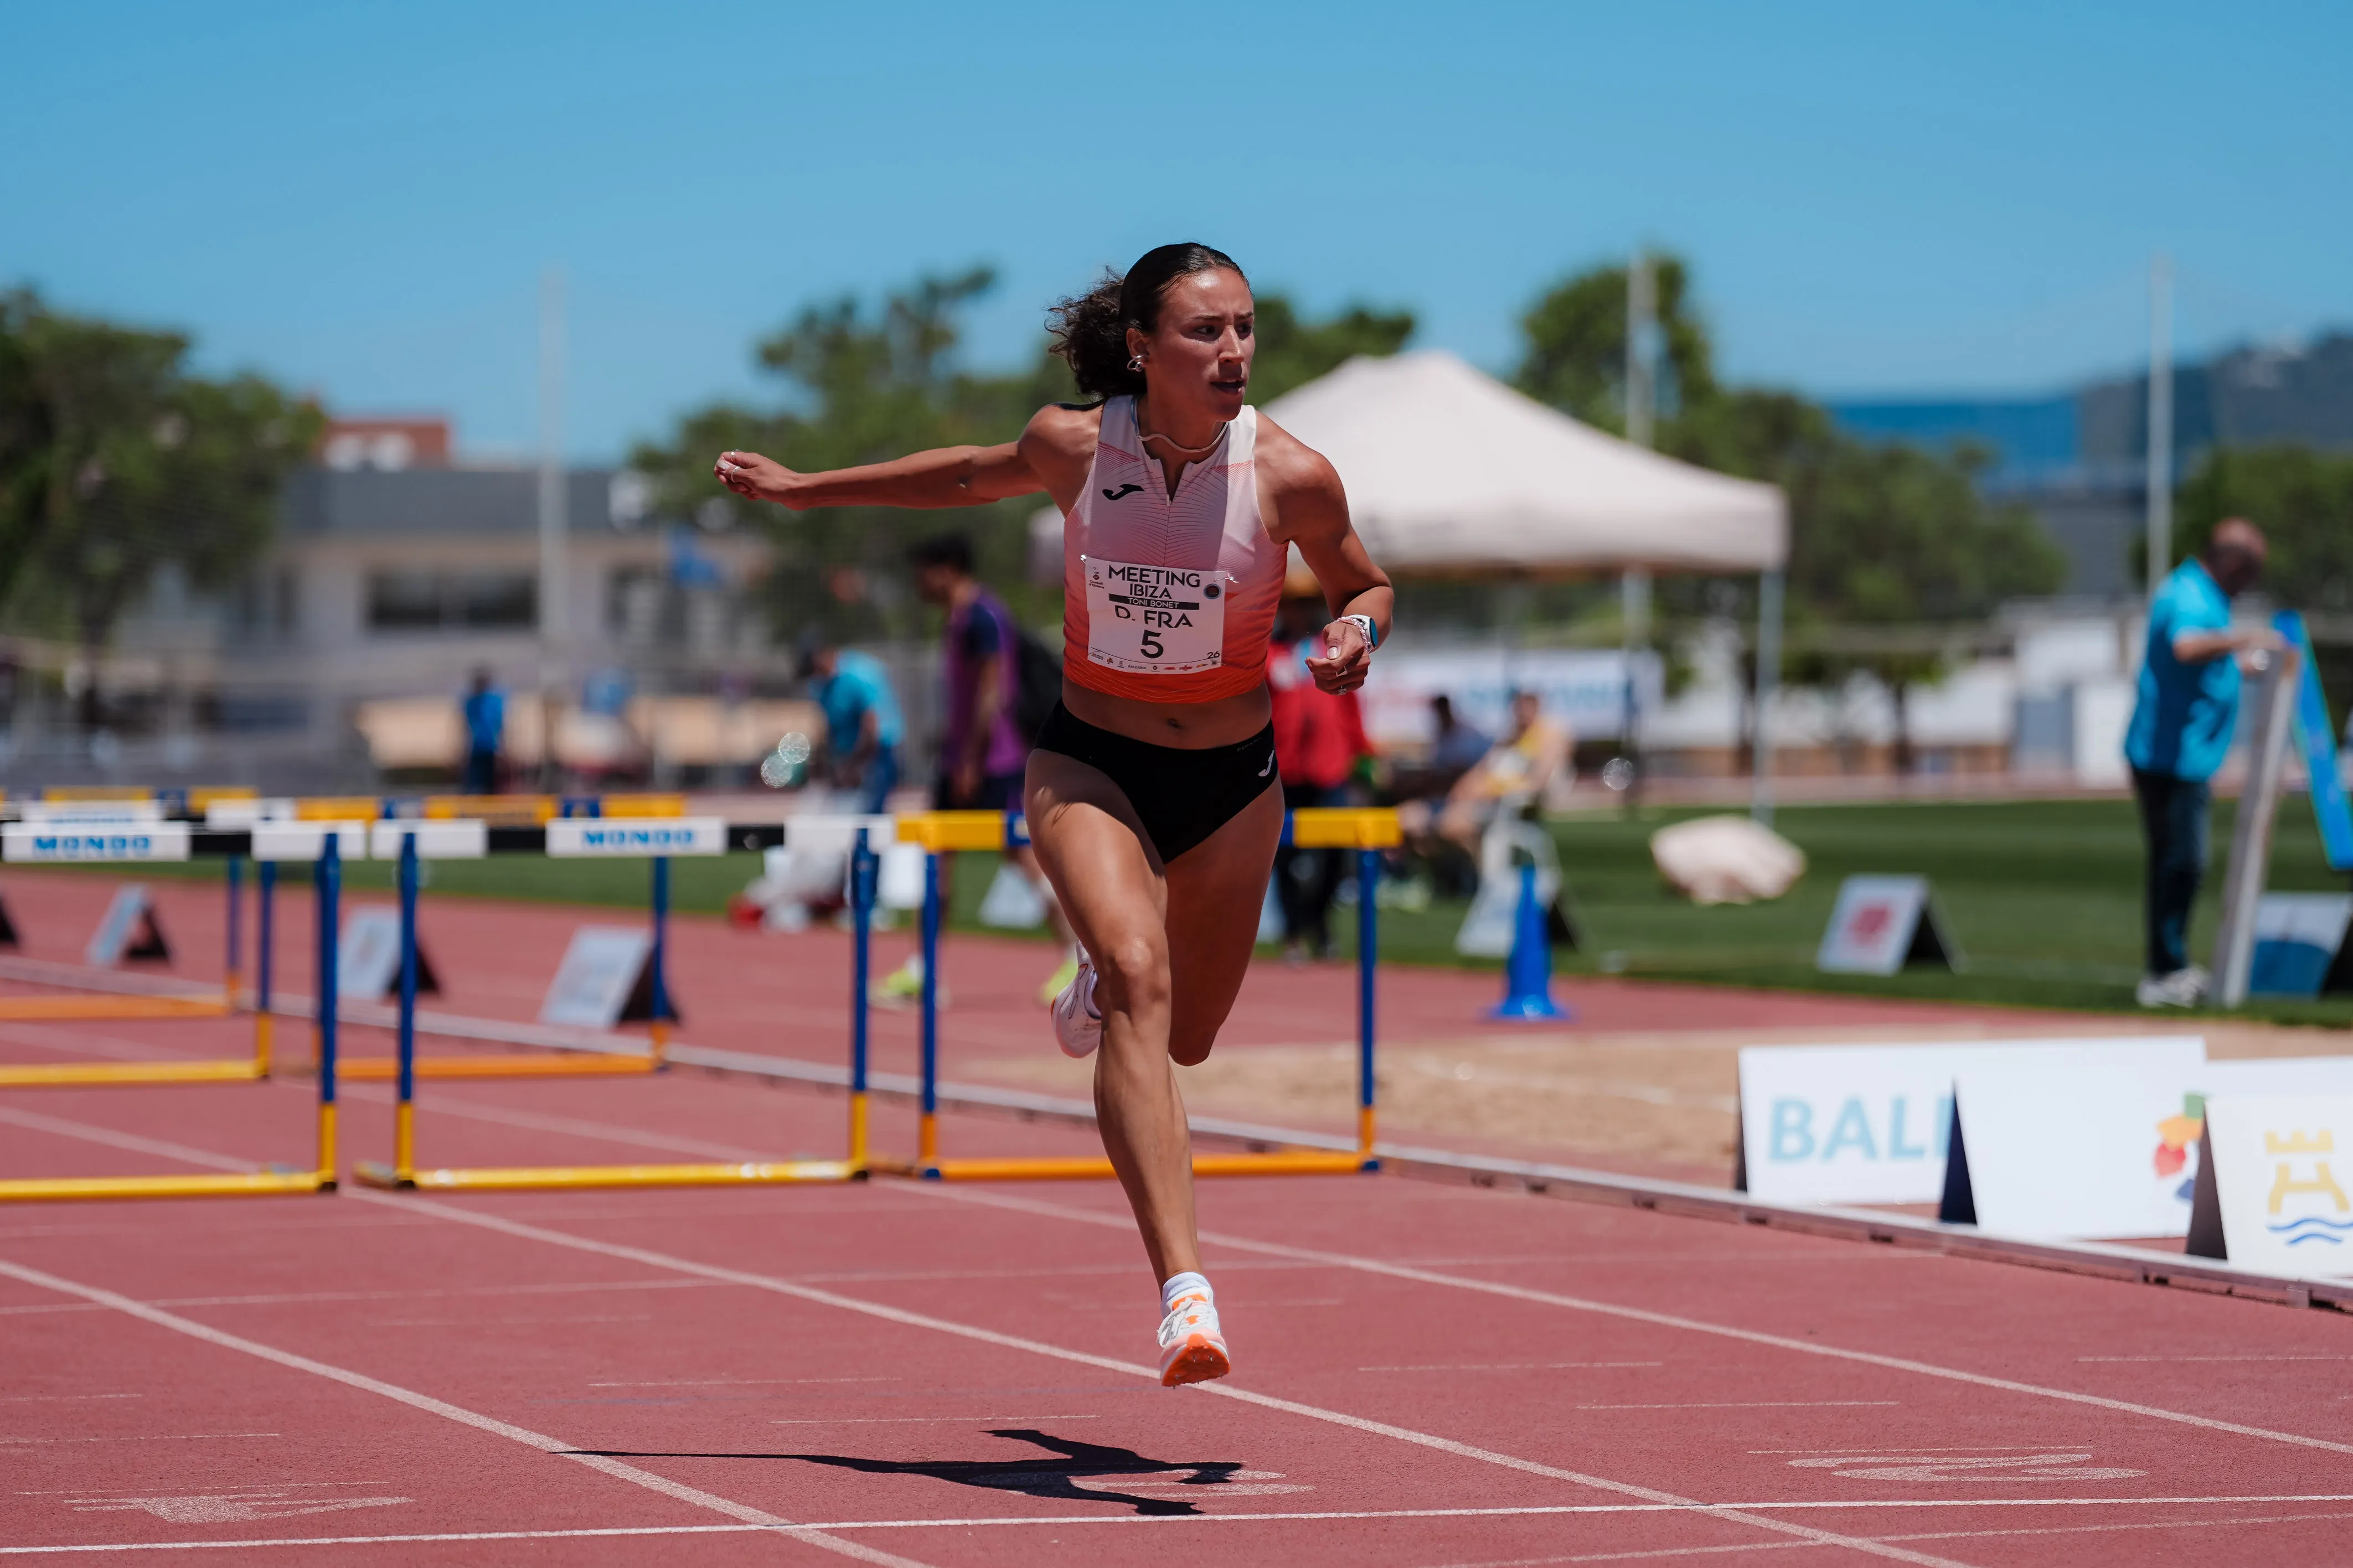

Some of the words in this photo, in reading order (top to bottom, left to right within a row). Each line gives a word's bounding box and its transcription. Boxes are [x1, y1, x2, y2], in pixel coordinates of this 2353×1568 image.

[1108, 565, 1200, 588] MEETING
[1129, 584, 1172, 599] IBIZA
[1127, 598, 1147, 606] TONI
[1150, 600, 1180, 609] BONET
[1115, 605, 1136, 621] D.
[1144, 610, 1193, 628] FRA
[1141, 630, 1163, 658] 5
[1207, 650, 1220, 659] 26
[33, 835, 152, 856] MONDO
[585, 829, 694, 847] MONDO
